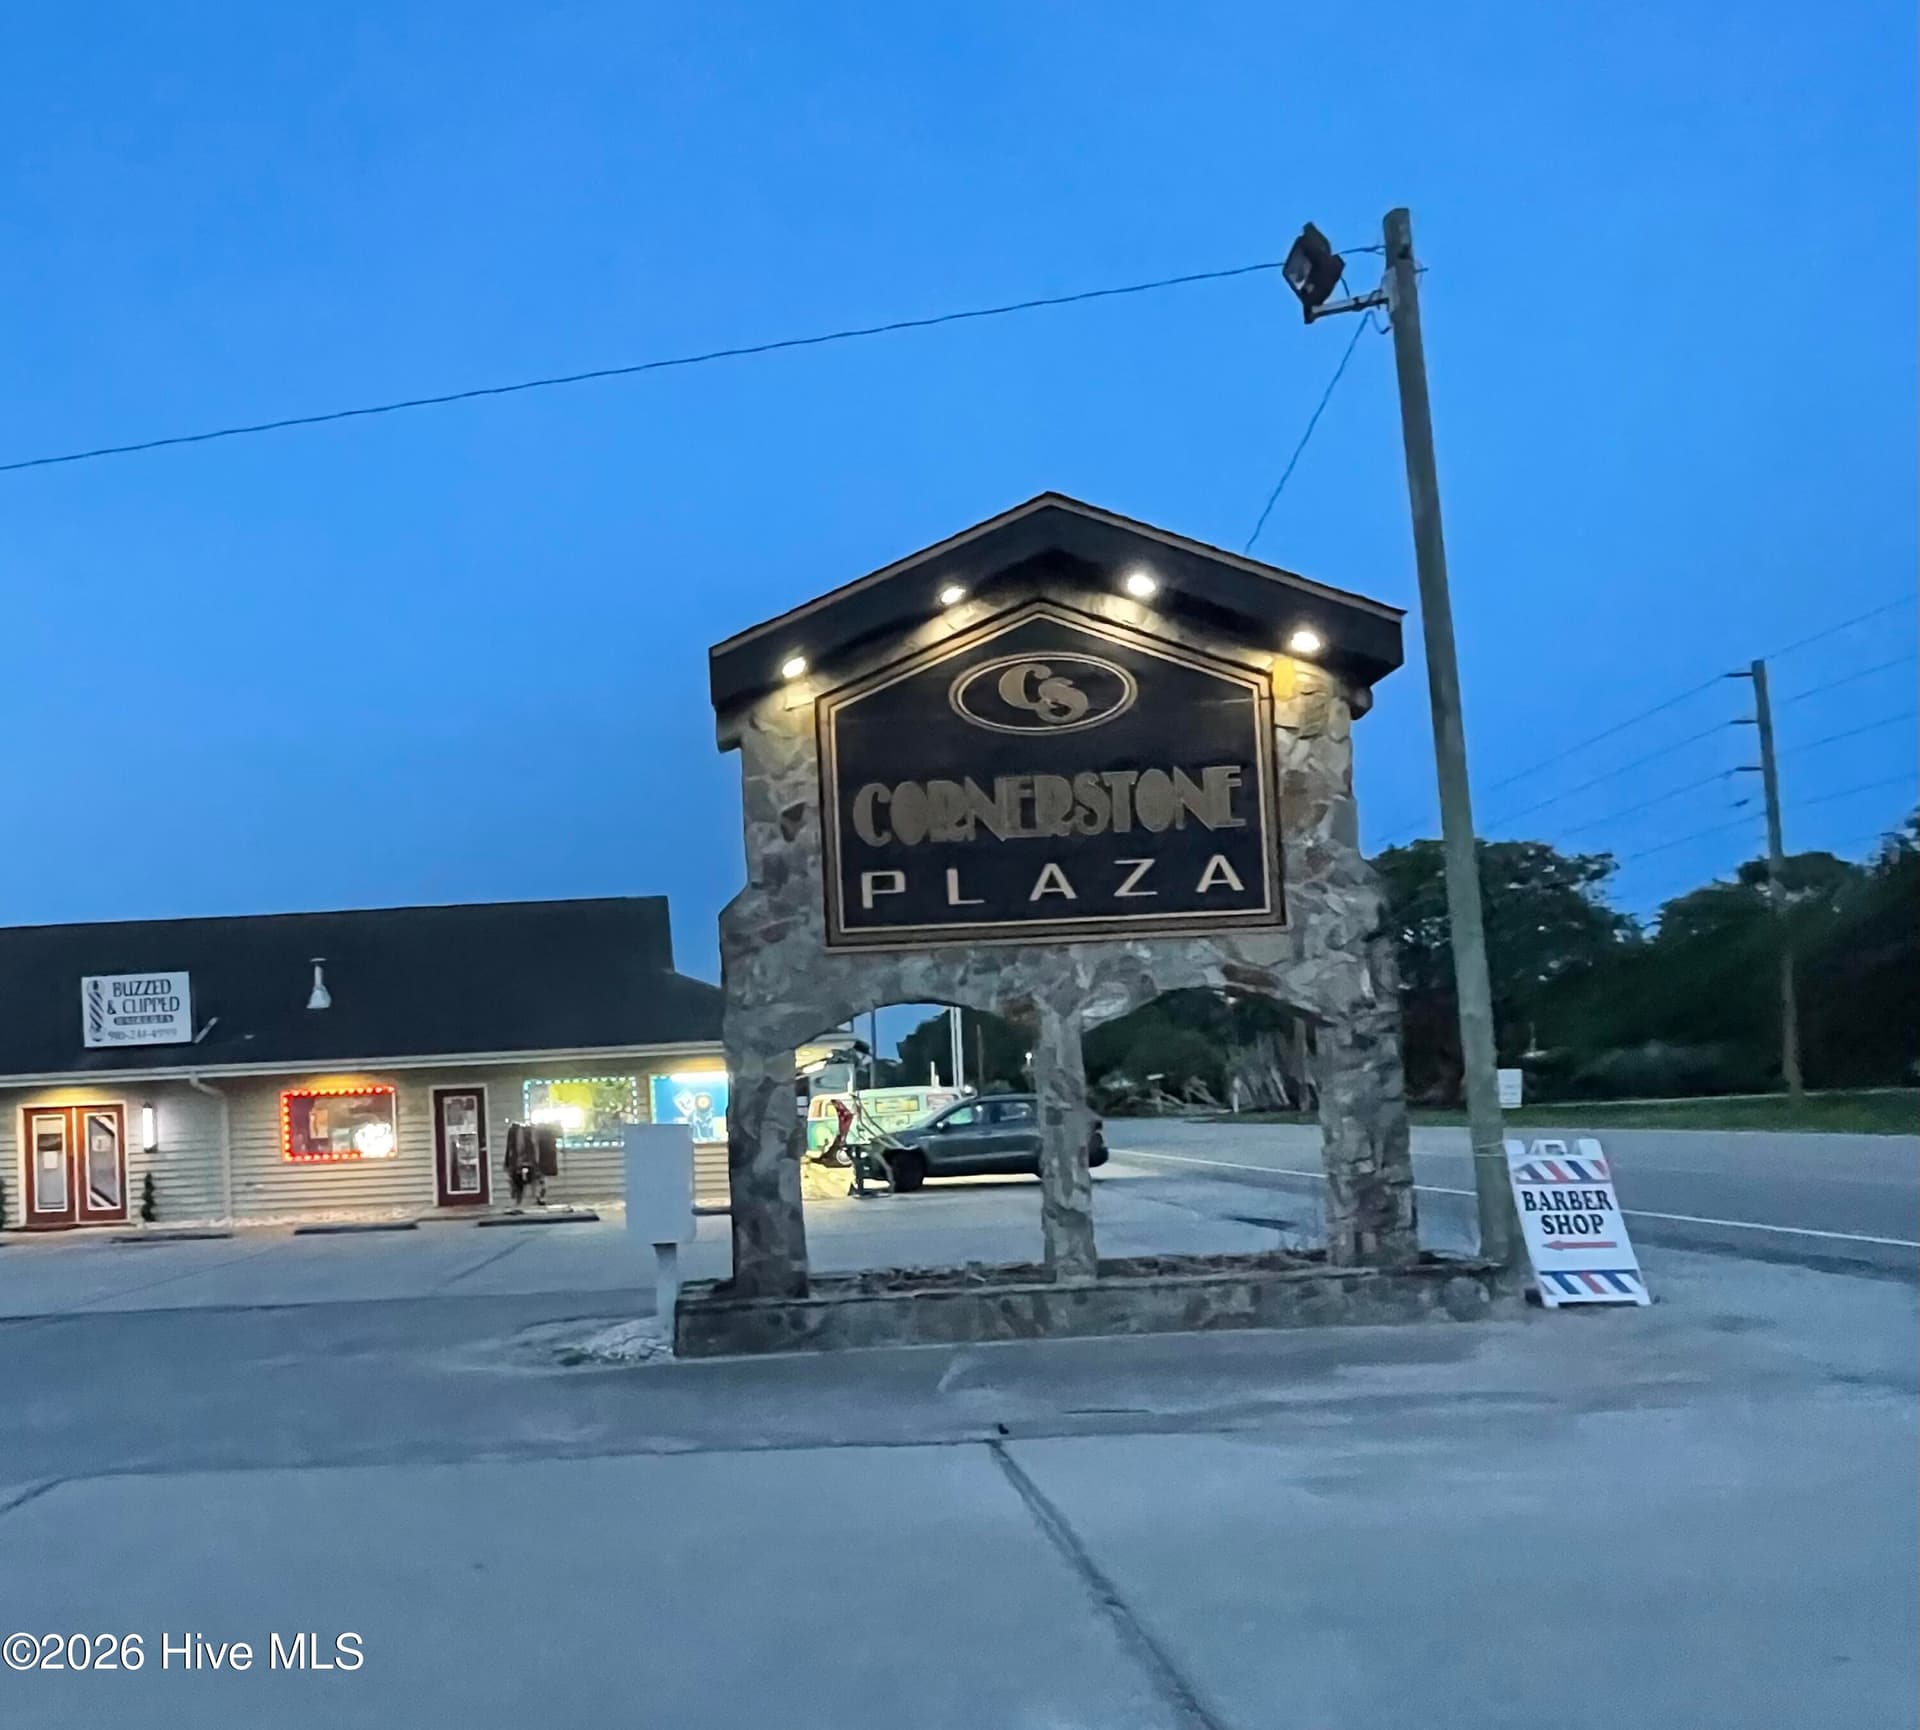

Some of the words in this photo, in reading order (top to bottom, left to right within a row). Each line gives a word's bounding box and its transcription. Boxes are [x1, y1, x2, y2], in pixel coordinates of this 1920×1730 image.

[999, 663, 1088, 724] CS
[853, 765, 1247, 846] CORNERSTONE
[861, 854, 1246, 909] PLAZA
[113, 979, 171, 997] BUZZED
[107, 1000, 117, 1015] &
[122, 996, 180, 1014] CLIPPED
[1522, 1190, 1613, 1212] BARBER
[1541, 1214, 1604, 1235] SHOP
